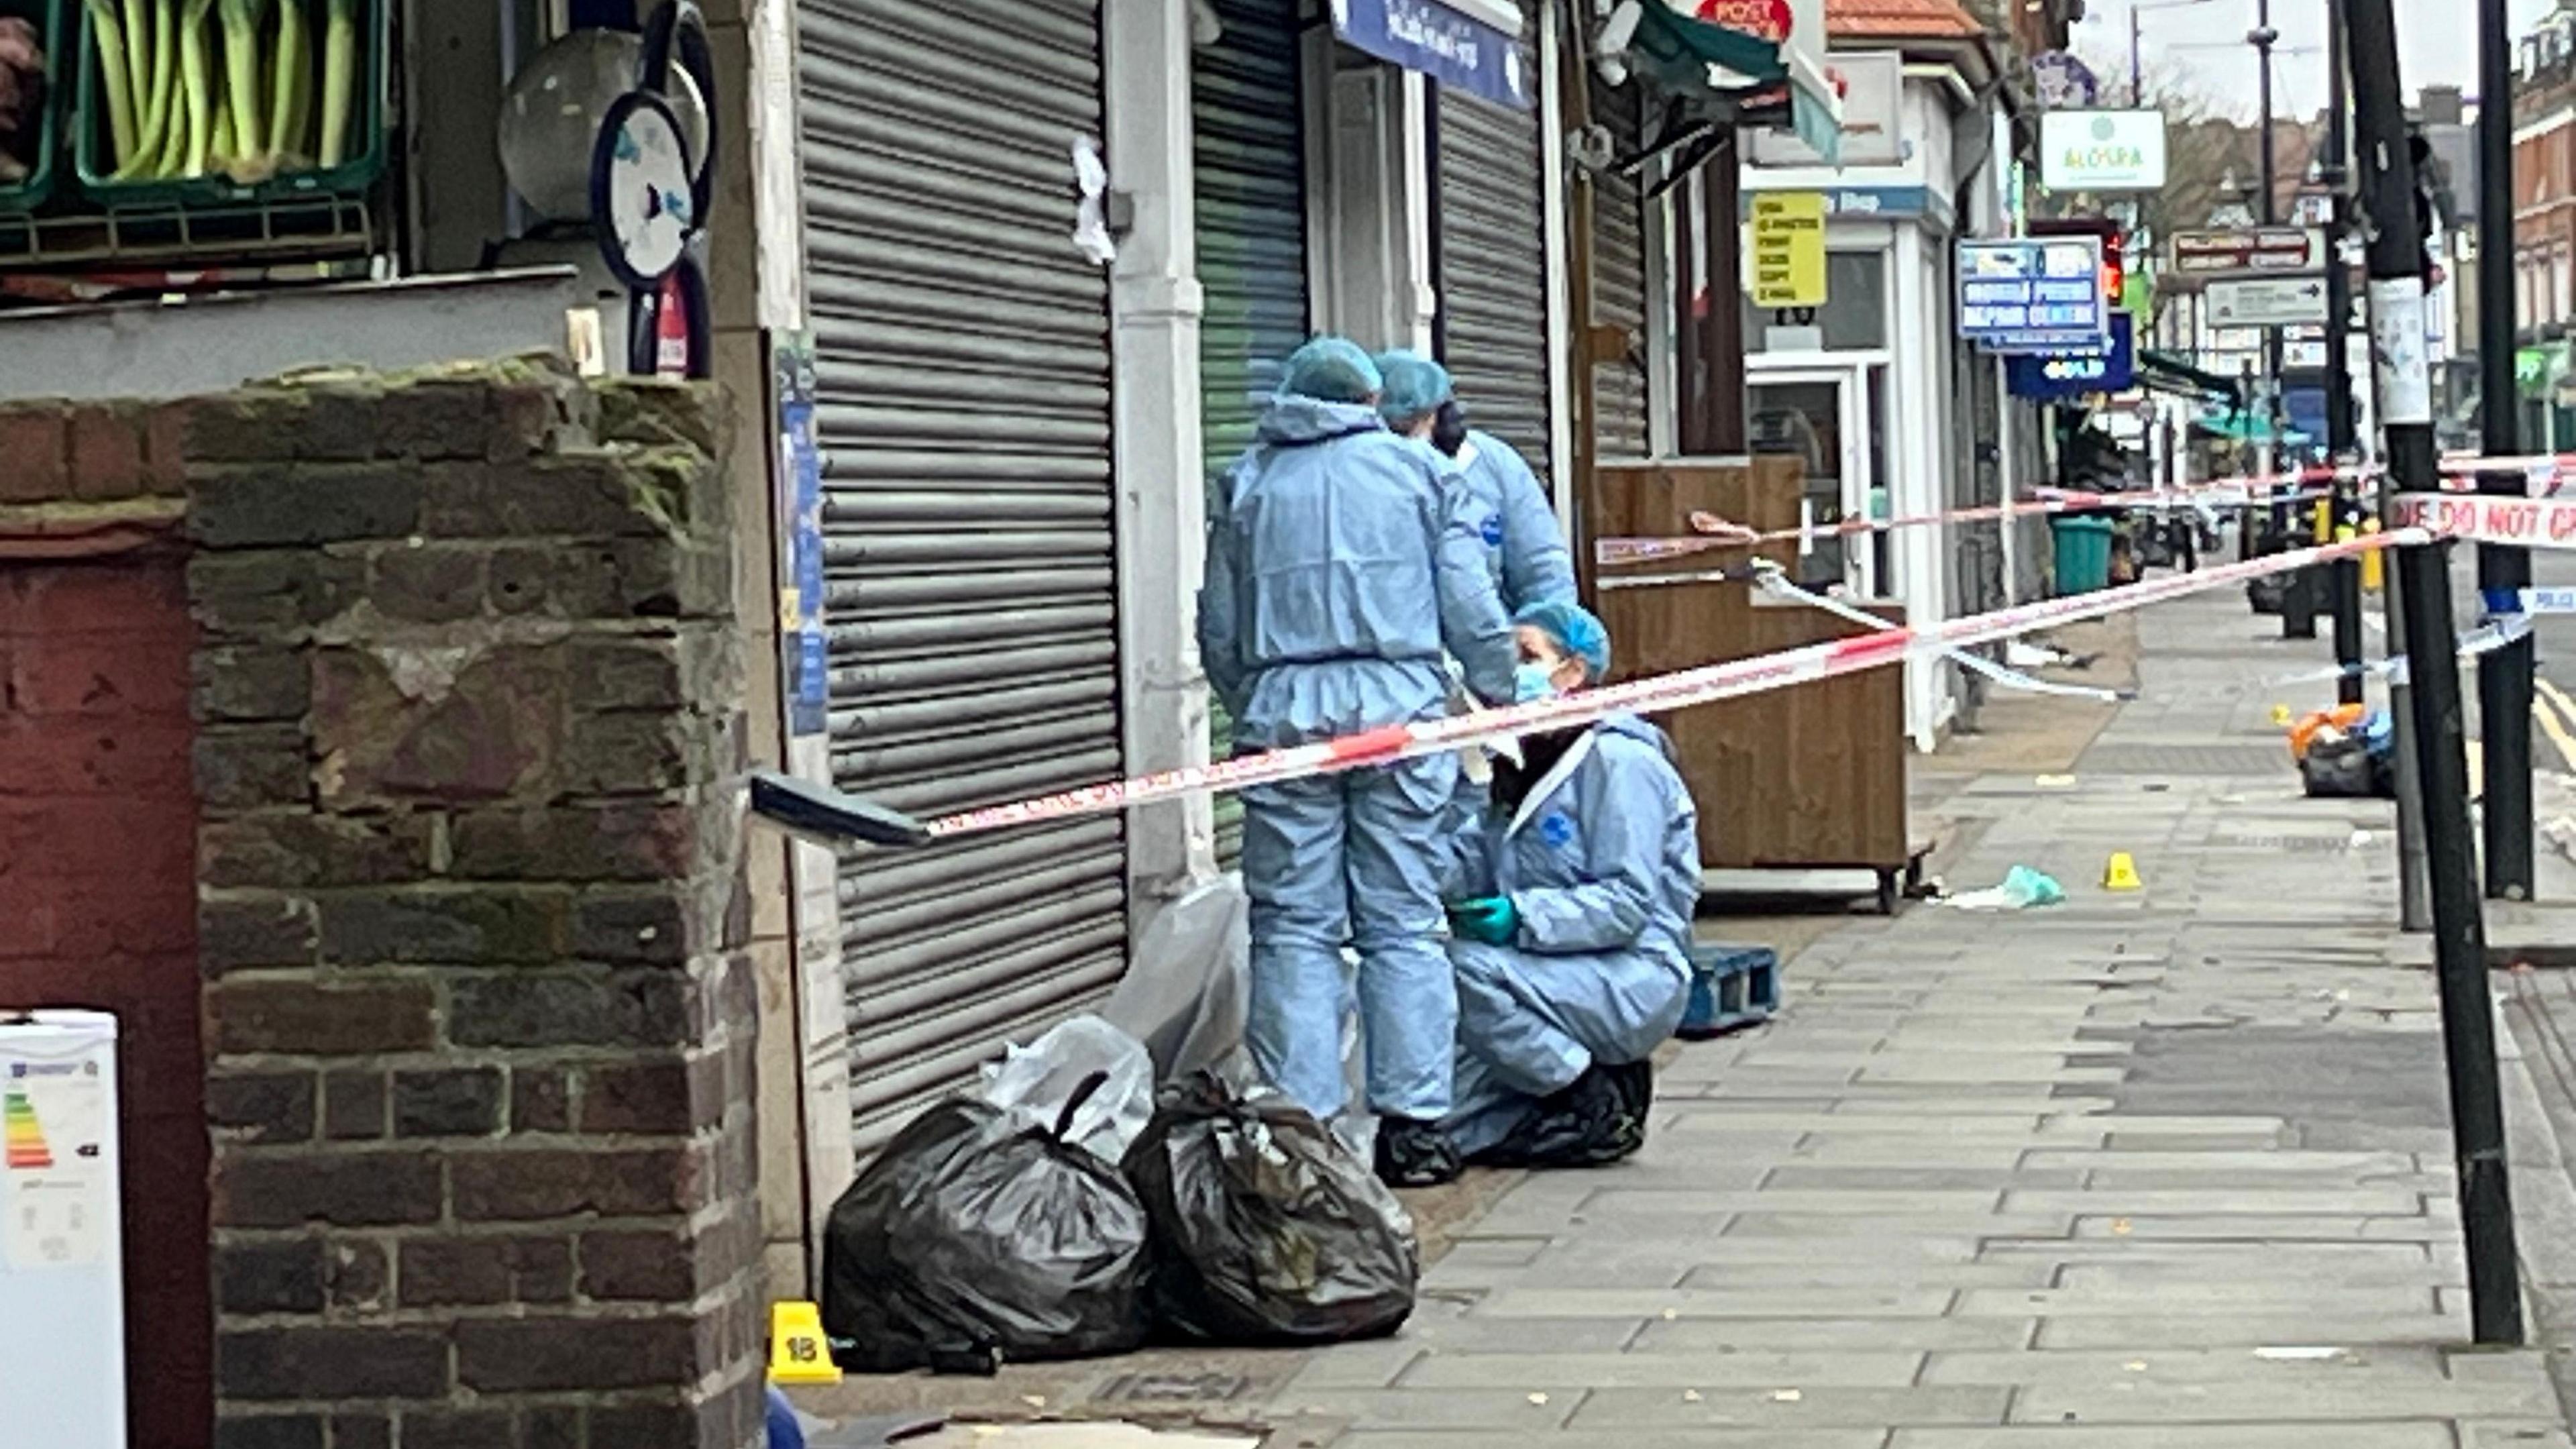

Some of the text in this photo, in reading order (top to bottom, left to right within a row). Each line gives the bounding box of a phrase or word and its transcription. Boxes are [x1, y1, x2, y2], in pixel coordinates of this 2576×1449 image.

[1715, 0, 1774, 22] POST
[2439, 501, 2476, 535] DO
[2488, 504, 2540, 538] NOT
[786, 1337, 817, 1362] 18
